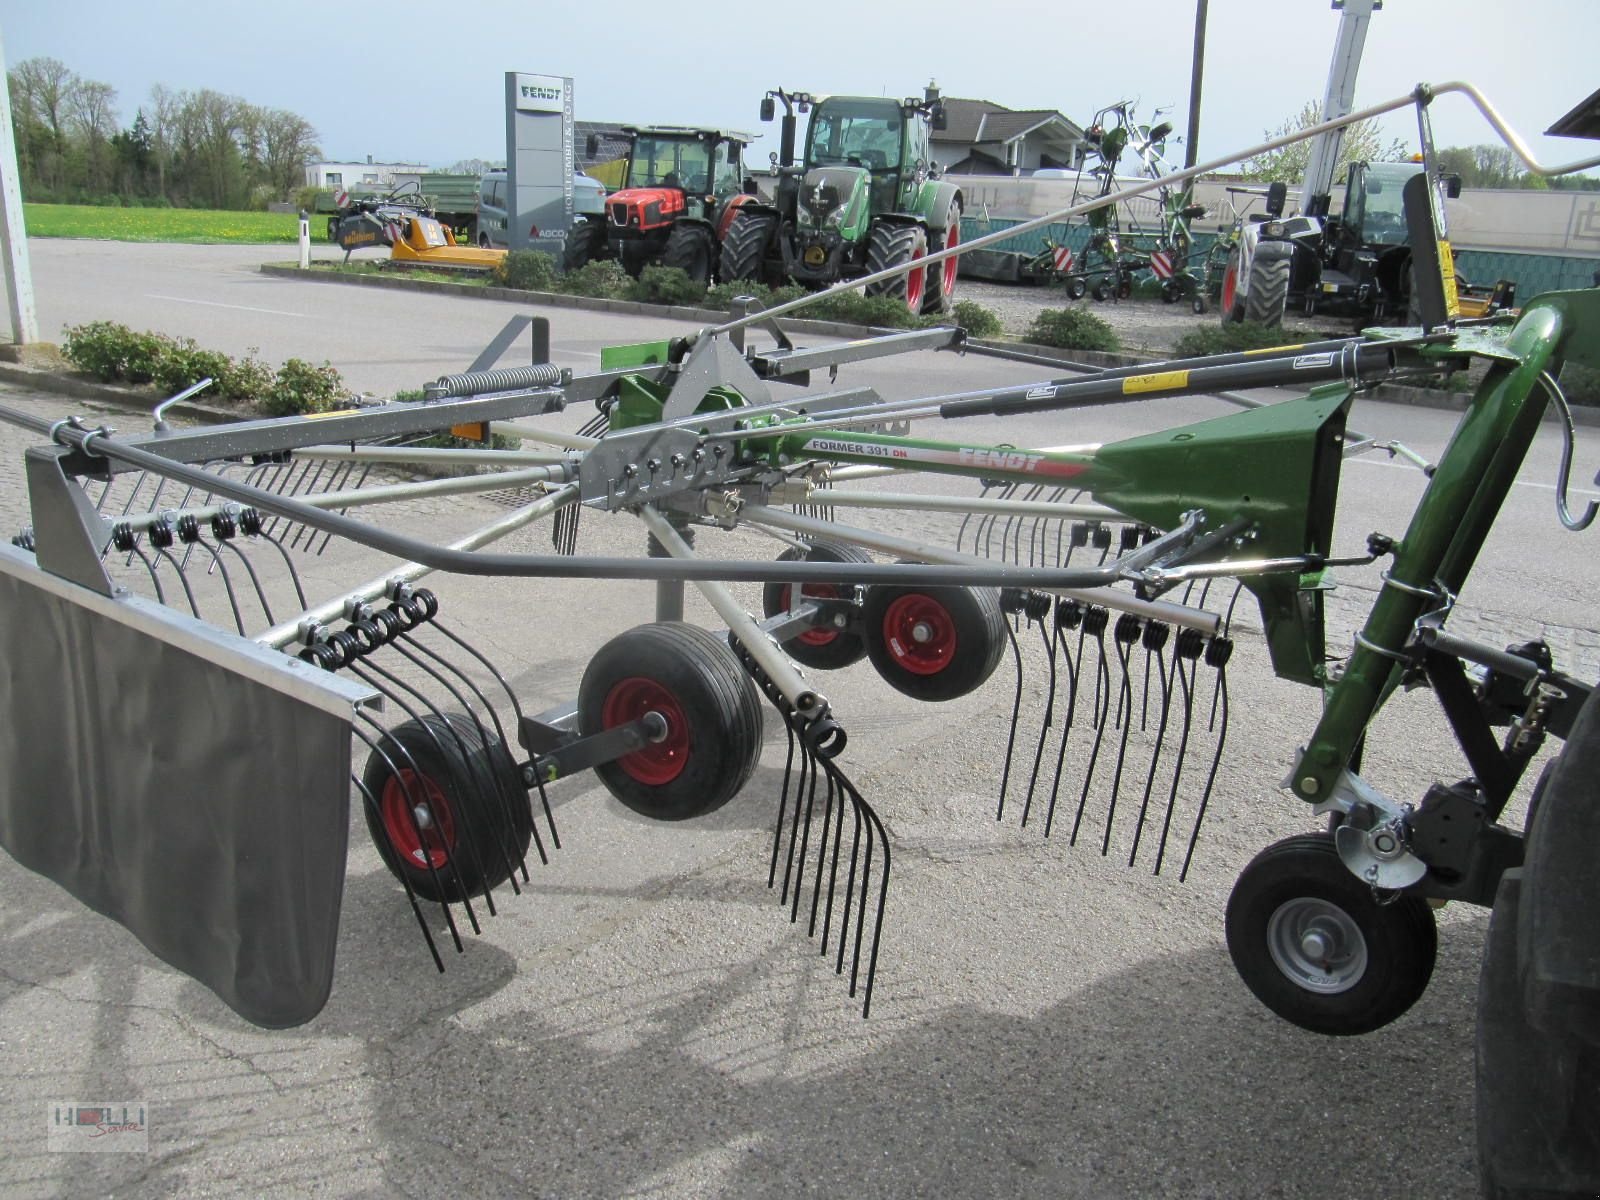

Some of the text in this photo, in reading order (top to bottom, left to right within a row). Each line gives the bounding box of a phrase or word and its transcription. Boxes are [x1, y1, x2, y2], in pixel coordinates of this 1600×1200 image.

[521, 86, 561, 100] FENDT
[565, 84, 572, 102] KG
[539, 229, 565, 238] AGCO
[812, 440, 907, 458] FORMER 391 DN
[960, 448, 1045, 471] FENDT
